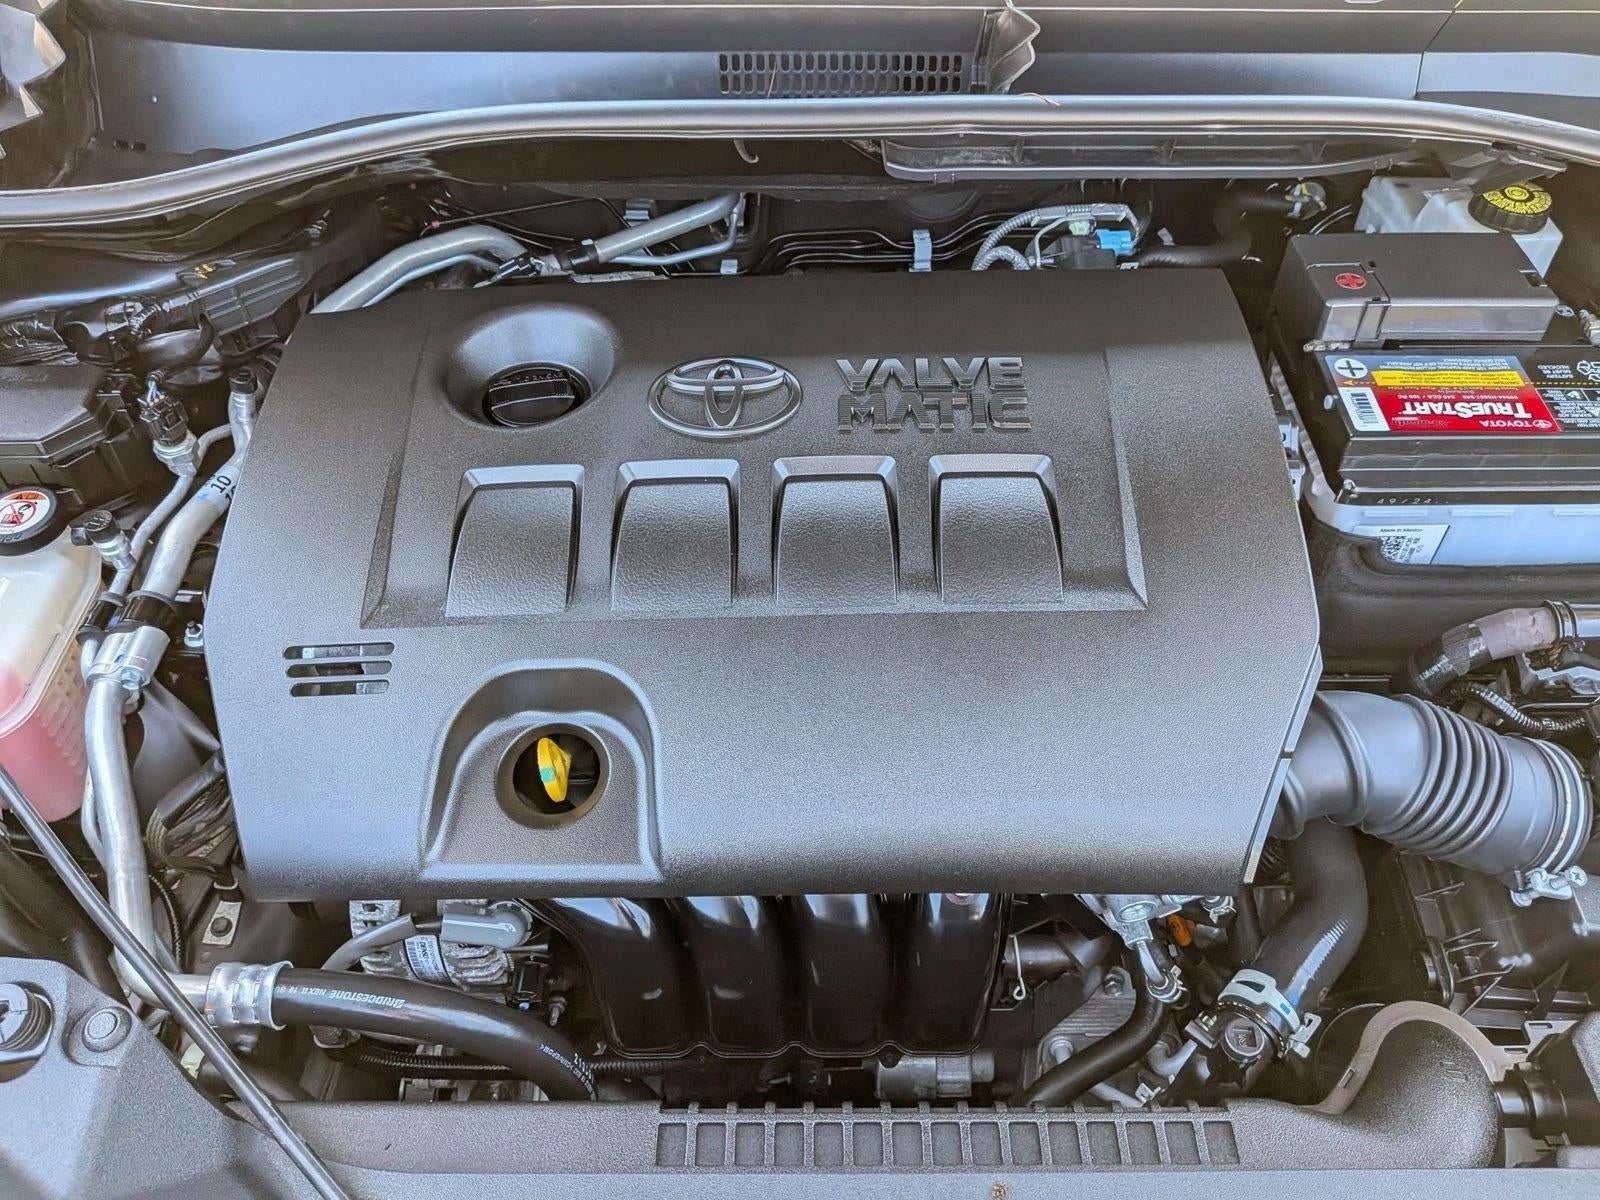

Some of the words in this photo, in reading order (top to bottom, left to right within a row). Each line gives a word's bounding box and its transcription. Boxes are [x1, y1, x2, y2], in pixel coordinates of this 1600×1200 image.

[836, 357, 1026, 391] VALVE
[838, 393, 1031, 433] MATIC
[1479, 419, 1533, 428] TOYOTA
[211, 475, 232, 494] 10
[329, 988, 406, 1009] BRIDGESTONE
